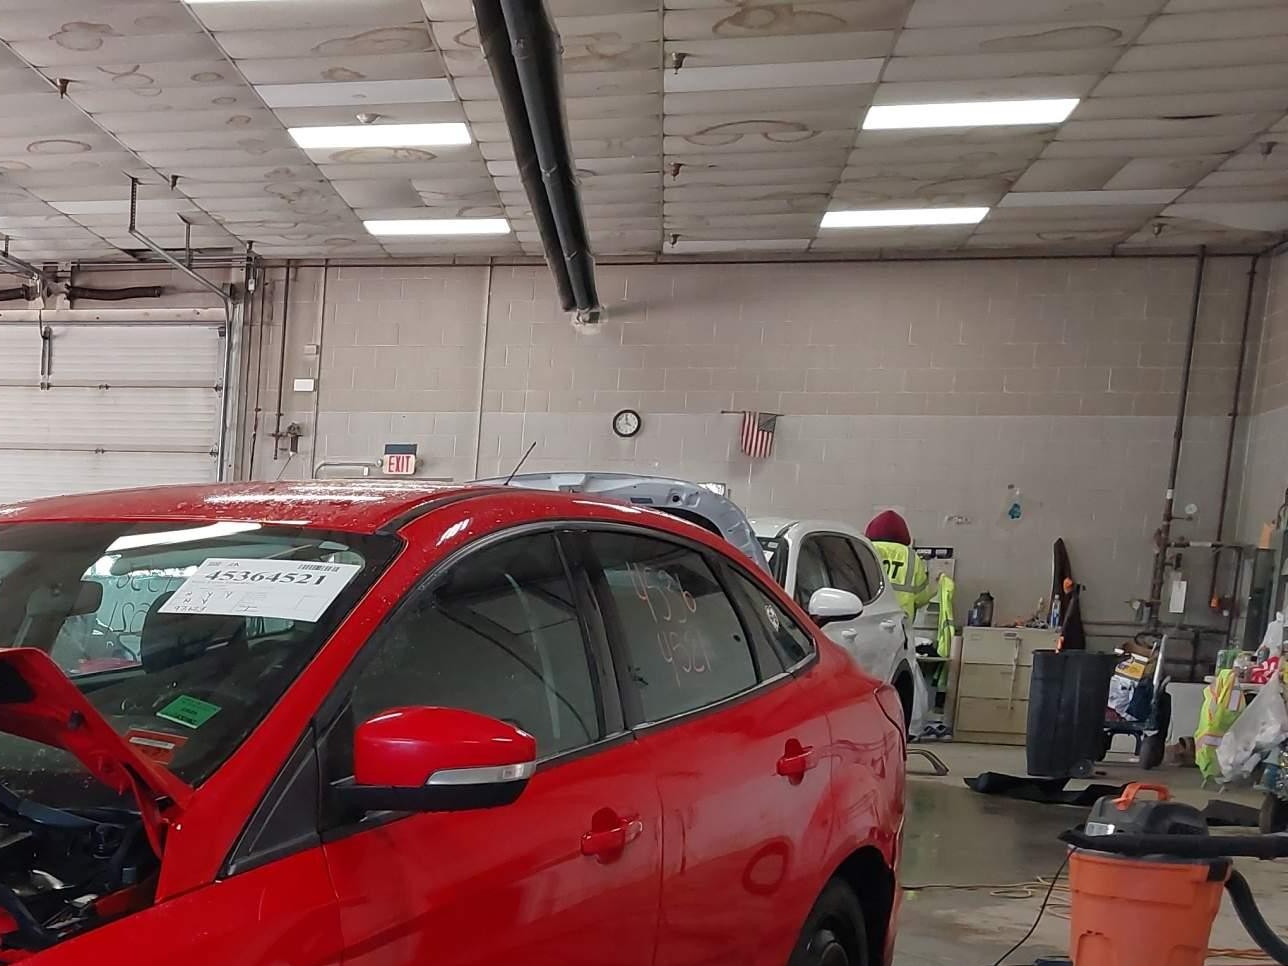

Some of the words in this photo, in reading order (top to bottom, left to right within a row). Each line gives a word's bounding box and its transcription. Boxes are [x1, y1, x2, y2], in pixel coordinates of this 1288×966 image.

[388, 455, 411, 472] EXIT
[205, 570, 327, 585] 45364521
[625, 561, 697, 623] 4536
